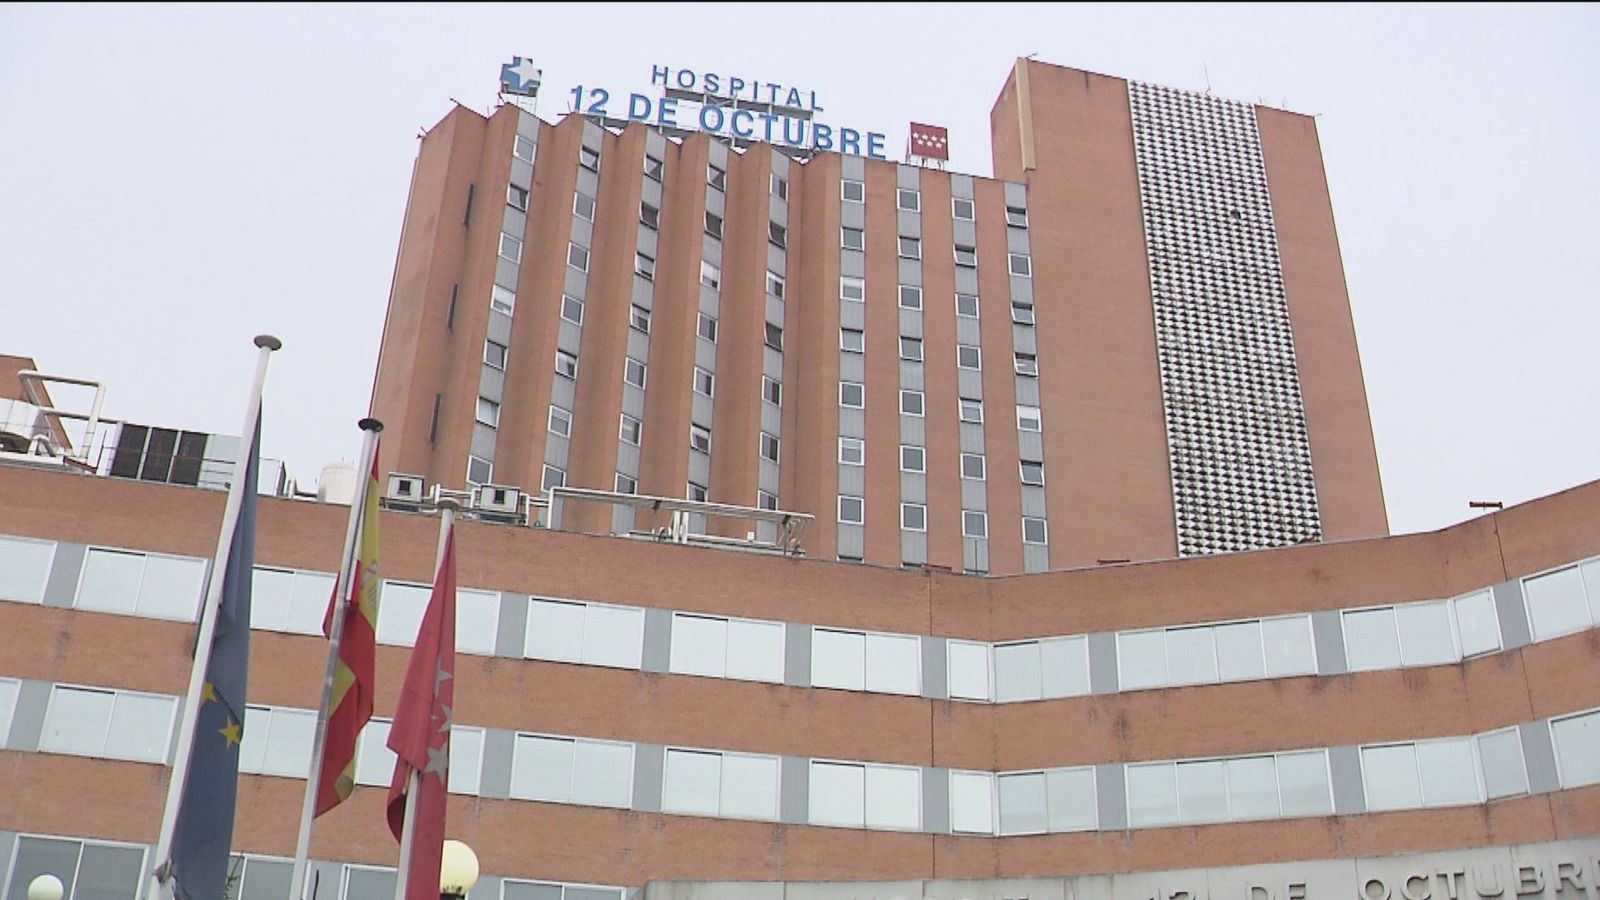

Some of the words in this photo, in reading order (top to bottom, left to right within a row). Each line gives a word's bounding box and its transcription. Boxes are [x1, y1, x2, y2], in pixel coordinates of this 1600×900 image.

[651, 64, 824, 112] HOSPITAL
[571, 84, 609, 115] 12
[628, 92, 679, 125] DE
[699, 104, 886, 159] OCTUBRE
